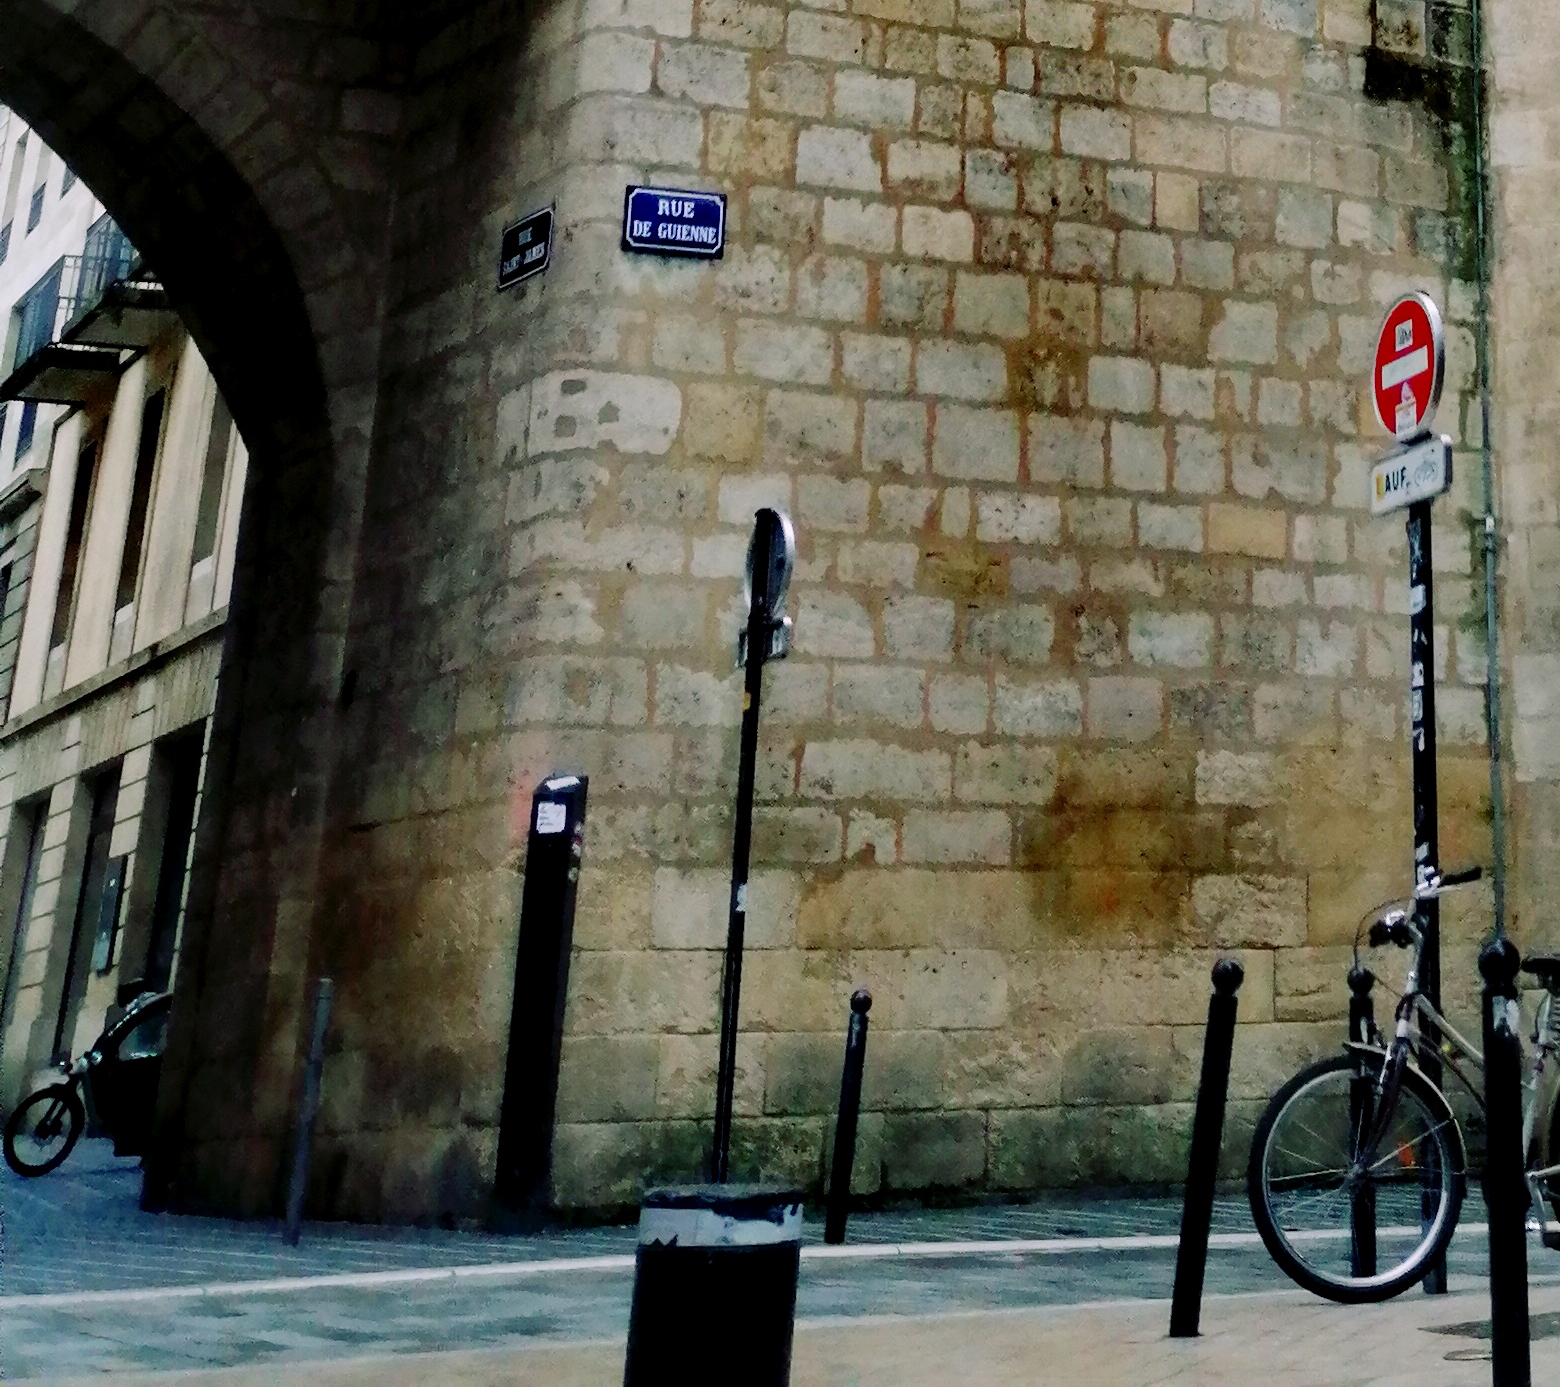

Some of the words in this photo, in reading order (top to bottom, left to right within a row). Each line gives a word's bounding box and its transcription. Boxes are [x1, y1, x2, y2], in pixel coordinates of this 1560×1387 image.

[657, 198, 695, 219] RUE
[632, 219, 652, 238] DE
[657, 223, 717, 244] GUIENNE
[1385, 466, 1407, 492] AUF
